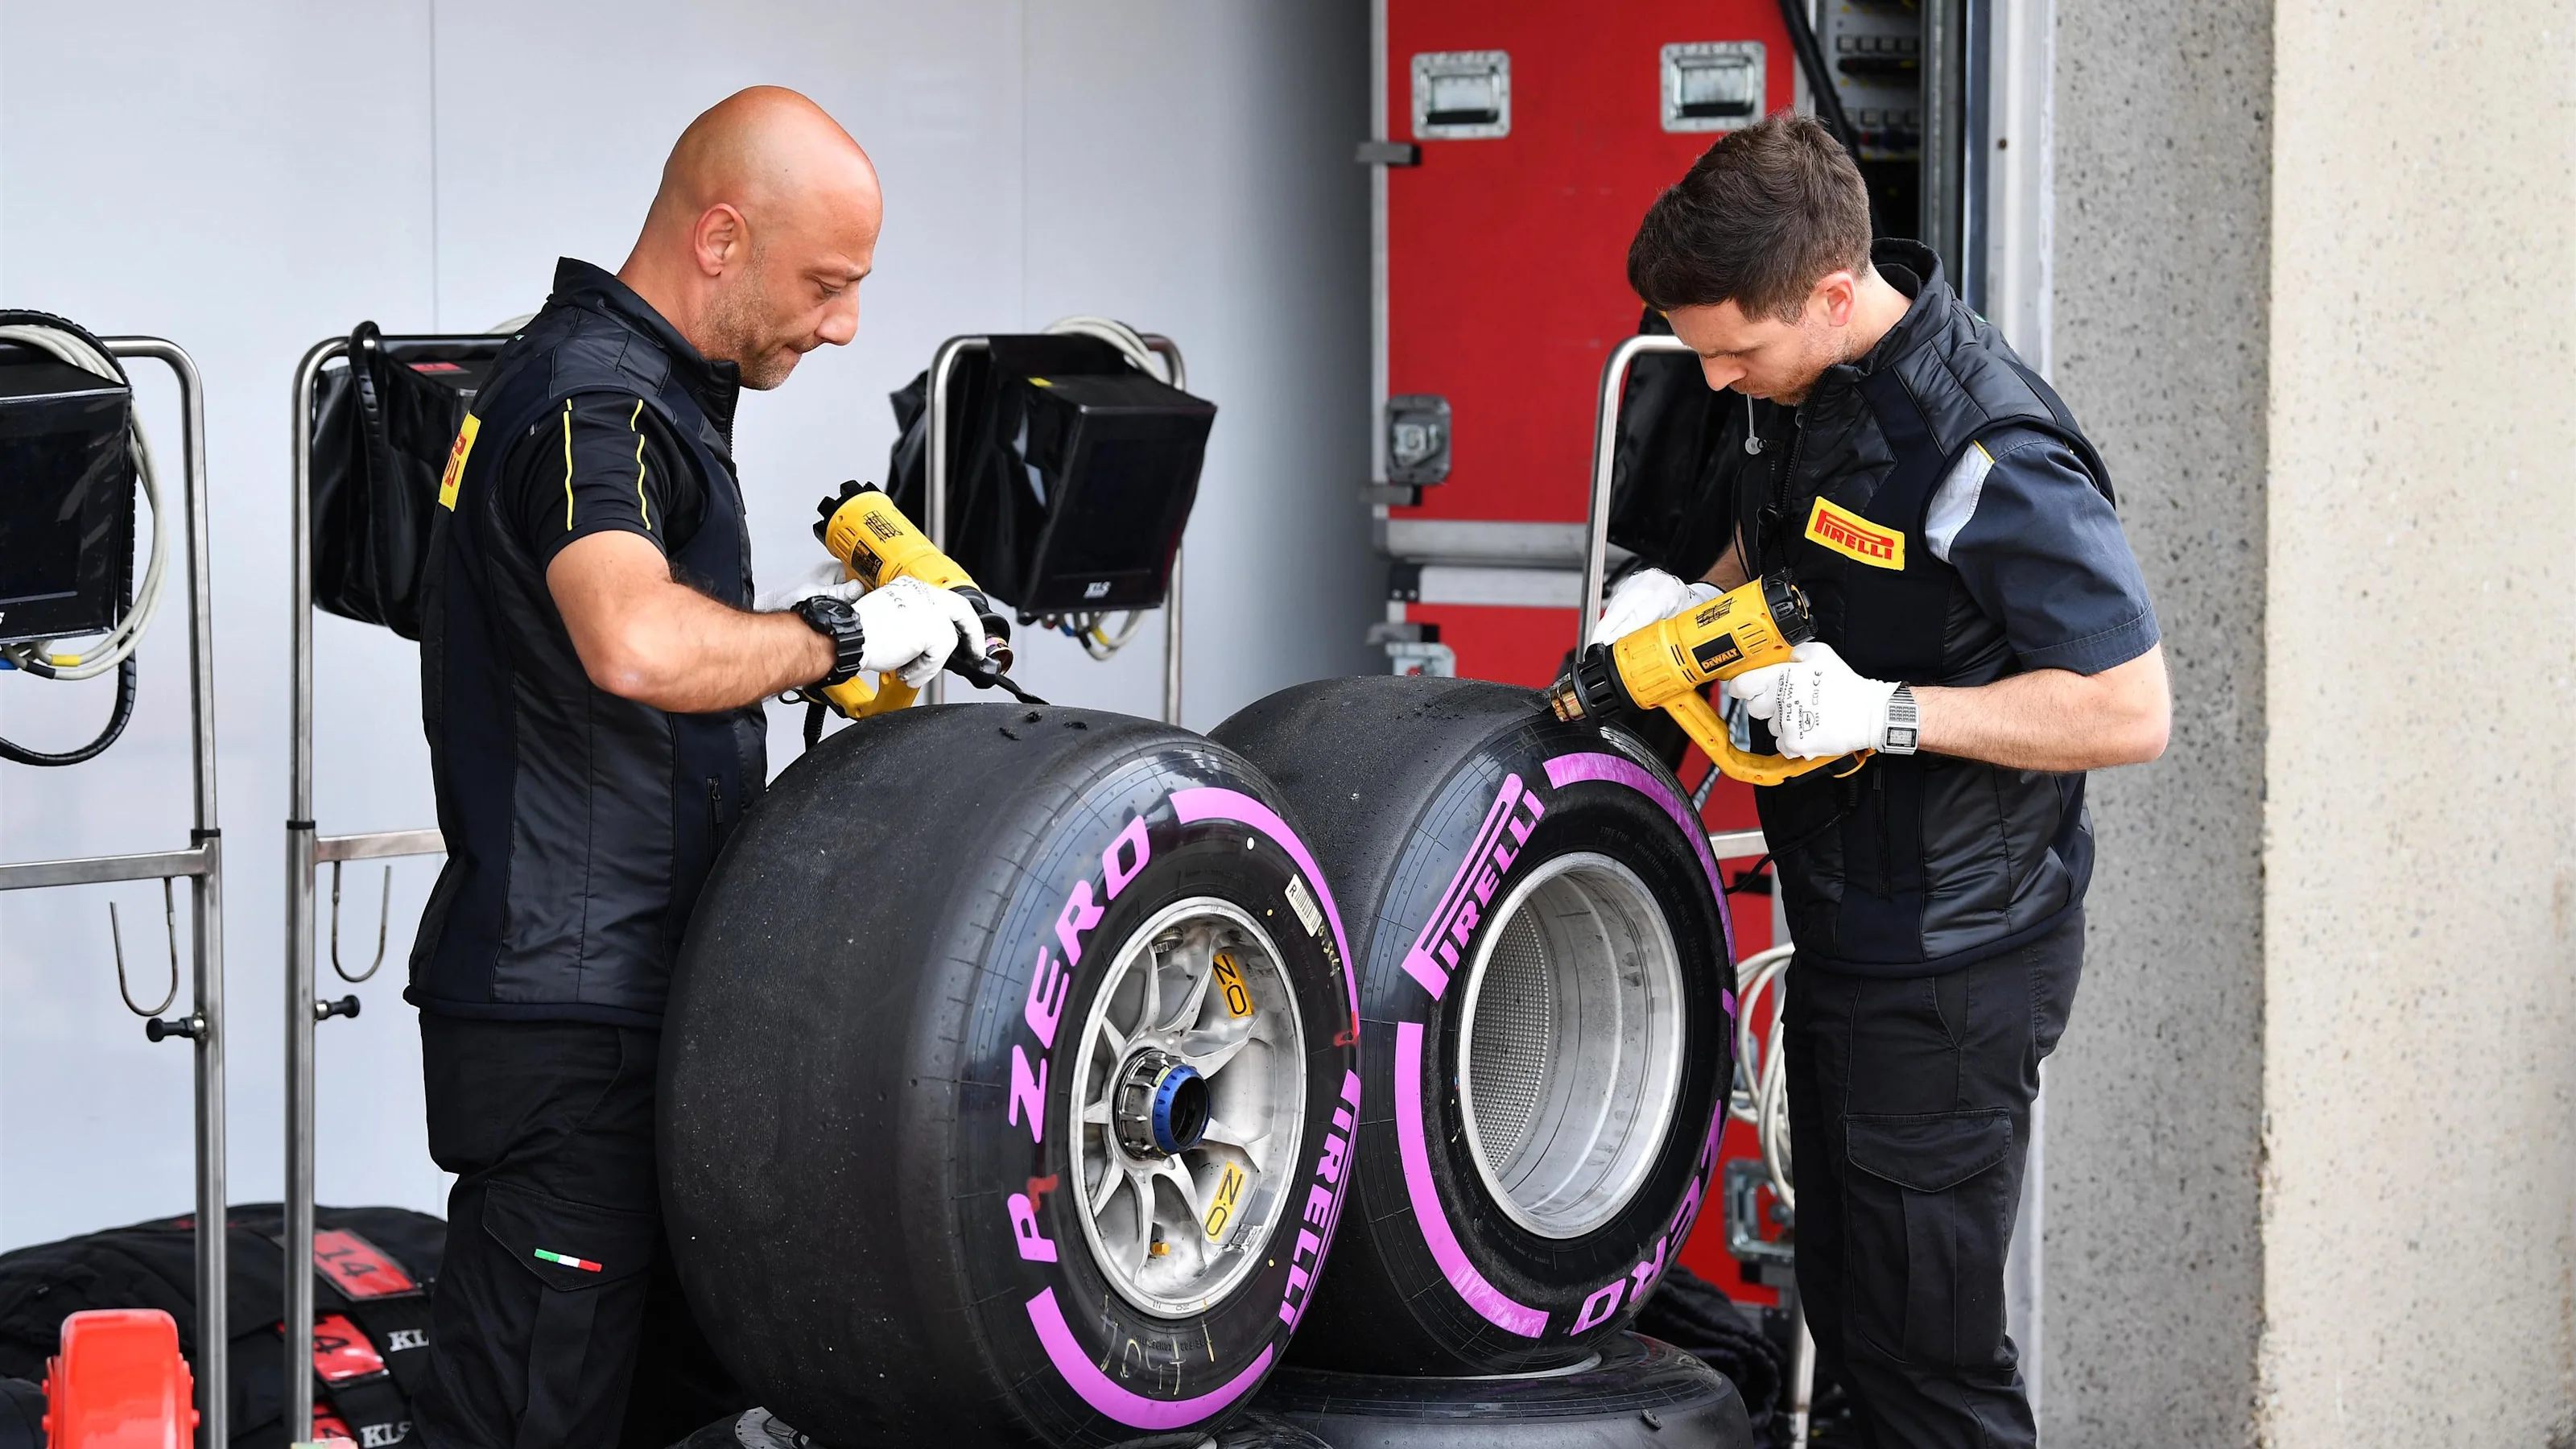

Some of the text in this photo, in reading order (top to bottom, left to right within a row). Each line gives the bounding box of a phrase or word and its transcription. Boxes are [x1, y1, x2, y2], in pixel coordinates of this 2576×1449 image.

[1814, 509, 1894, 560] PIRELLI
[1289, 884, 1298, 898] R
[1403, 773, 1545, 1001] PIRELLI
[1007, 815, 1151, 1263] P ZERO
[315, 1247, 377, 1277] 14
[1278, 1067, 1362, 1335] PIRELLI
[1571, 1098, 1723, 1336] ZERO
[387, 1329, 429, 1352] KL
